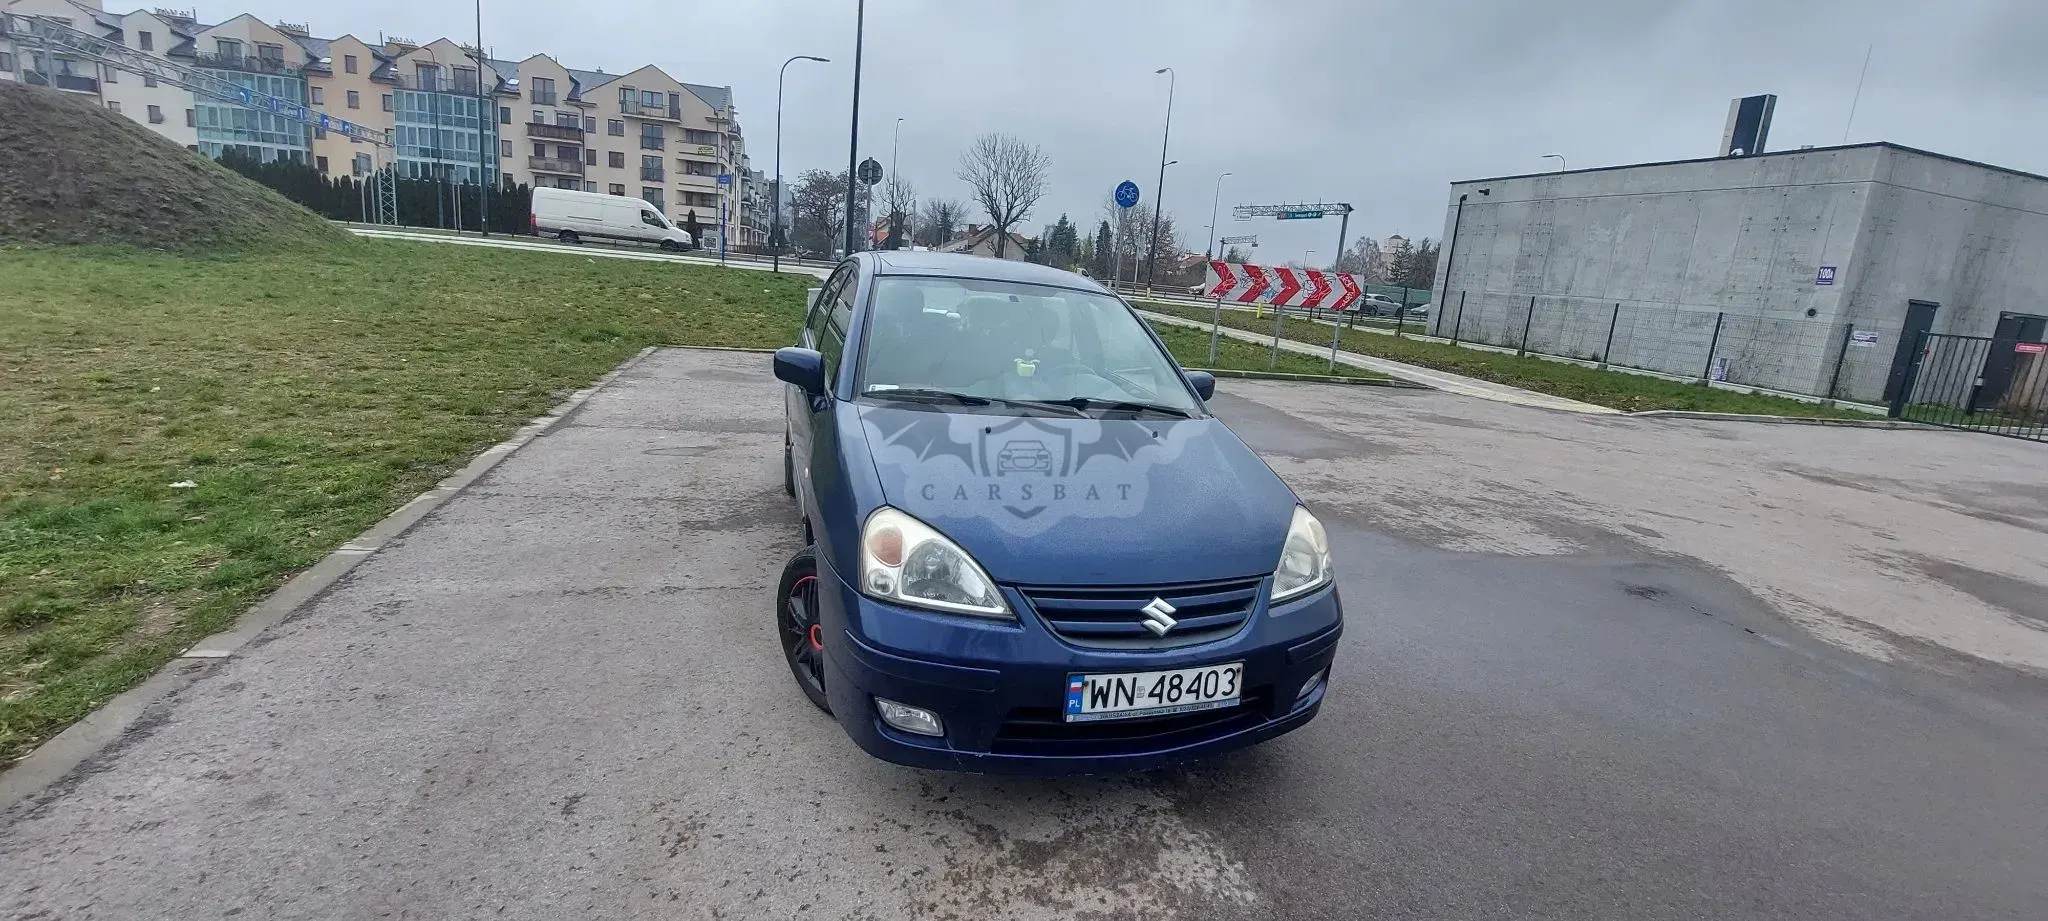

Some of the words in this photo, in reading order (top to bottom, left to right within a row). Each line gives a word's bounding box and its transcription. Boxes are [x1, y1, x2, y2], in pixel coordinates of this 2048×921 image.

[1090, 677, 1137, 709] WN
[1148, 668, 1236, 704] 48403
[1069, 699, 1080, 708] PL
